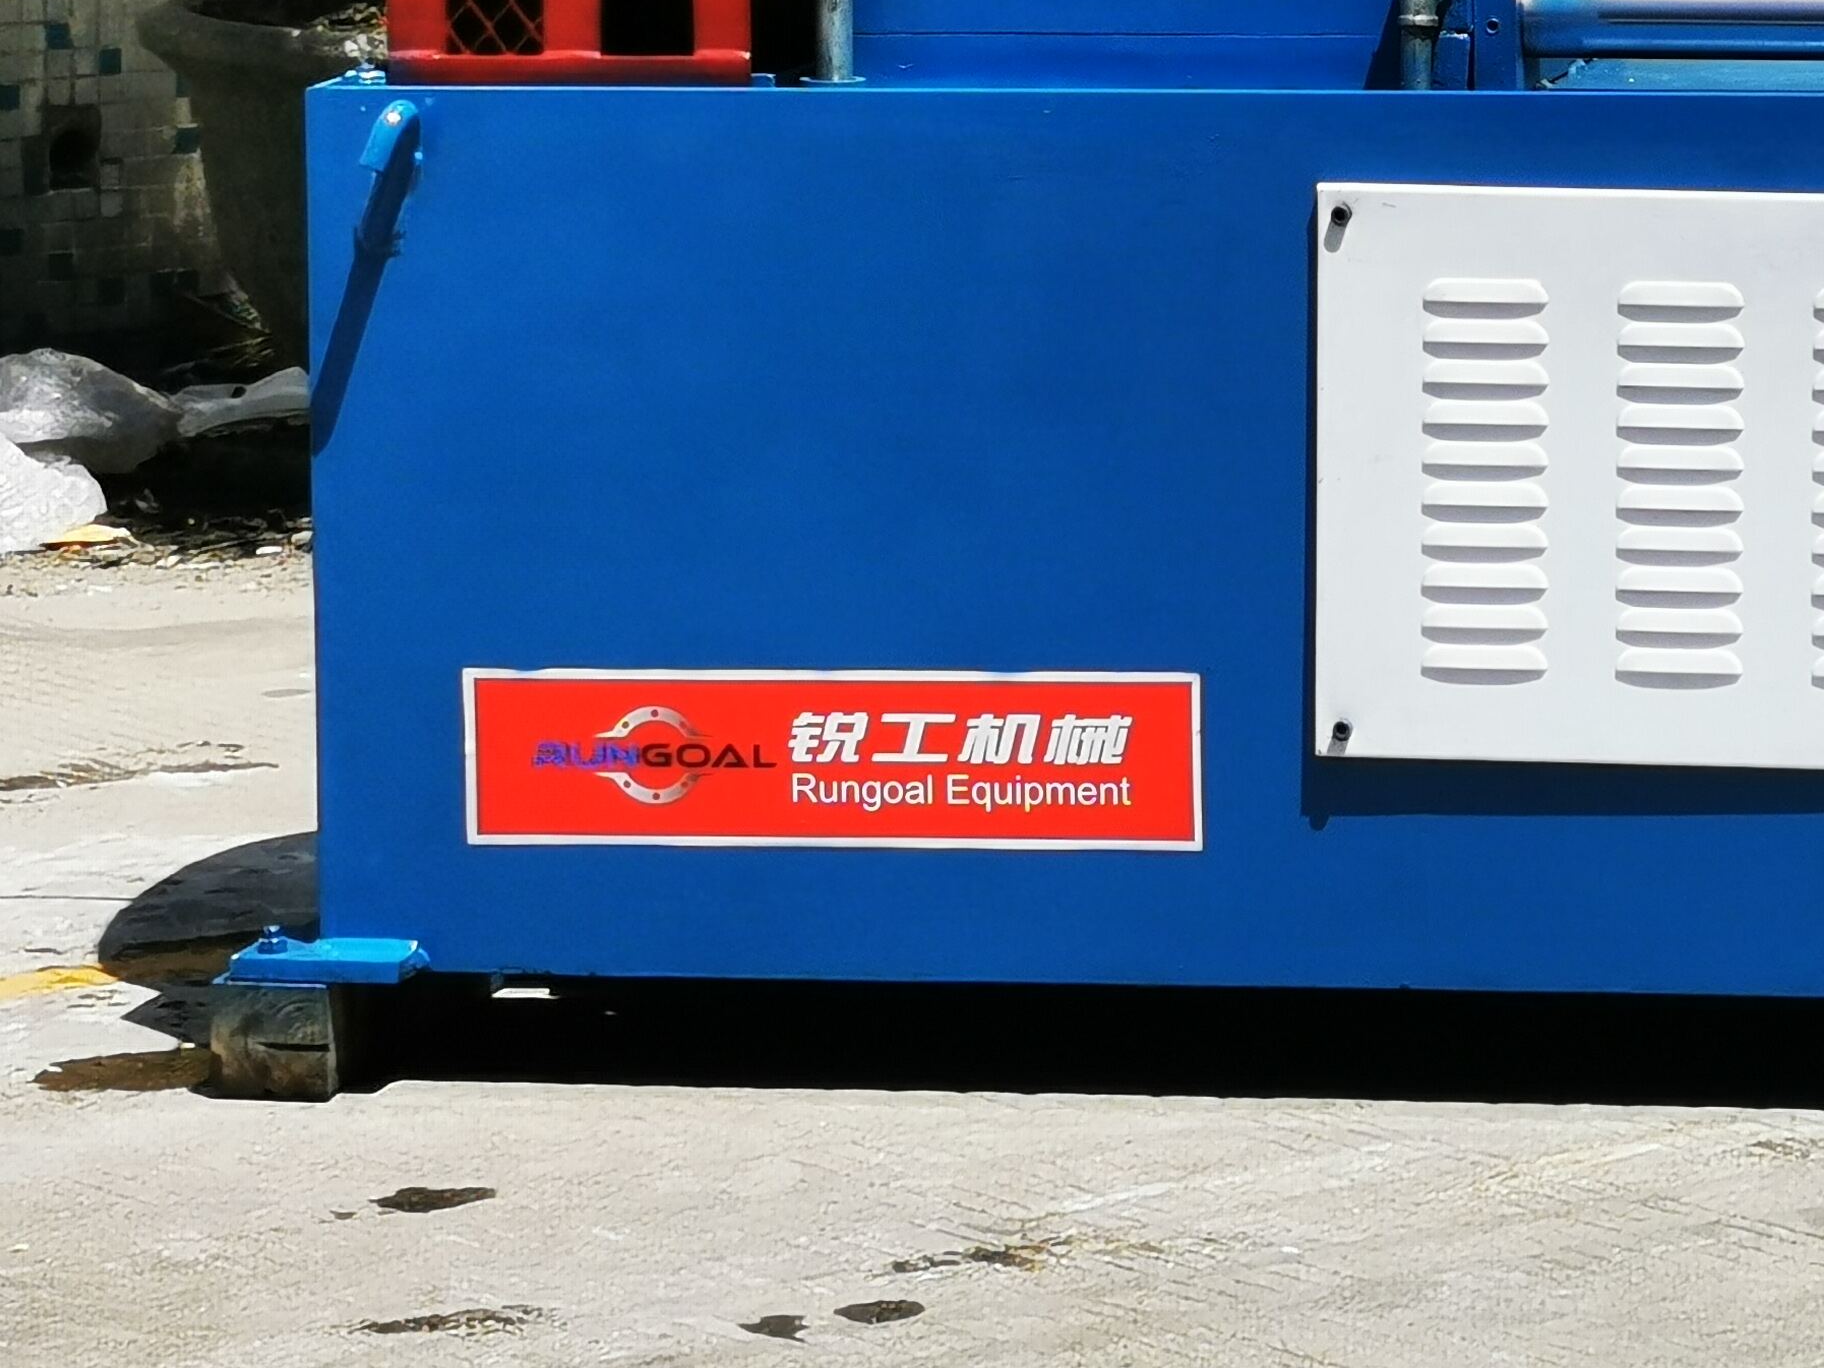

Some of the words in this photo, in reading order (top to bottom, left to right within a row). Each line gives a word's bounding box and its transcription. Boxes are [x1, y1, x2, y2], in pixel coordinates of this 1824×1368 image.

[788, 712, 1132, 766] 锐工机械
[792, 773, 933, 811] Rungoal
[947, 774, 1132, 812] Equipment
